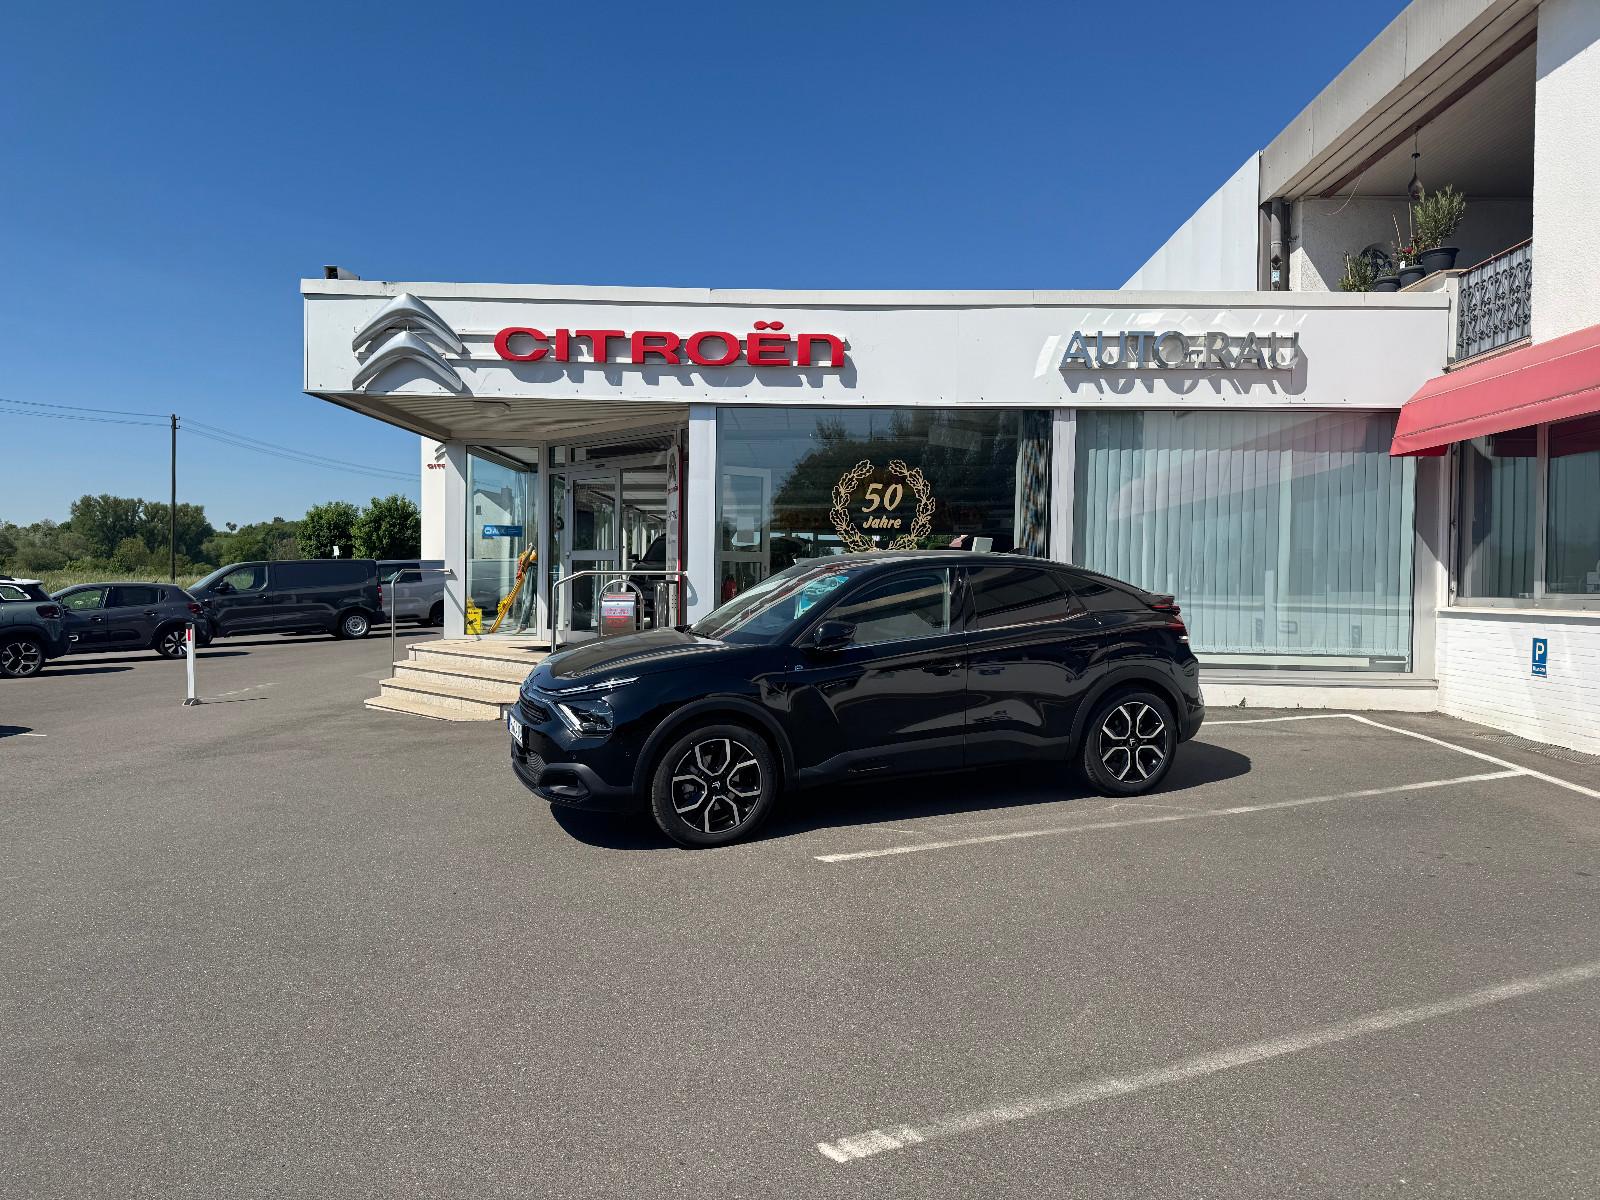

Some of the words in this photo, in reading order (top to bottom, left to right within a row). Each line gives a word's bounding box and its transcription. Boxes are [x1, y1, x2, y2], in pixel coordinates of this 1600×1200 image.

[861, 482, 904, 513] 50
[862, 514, 902, 529] Jahre
[1535, 642, 1545, 661] P
